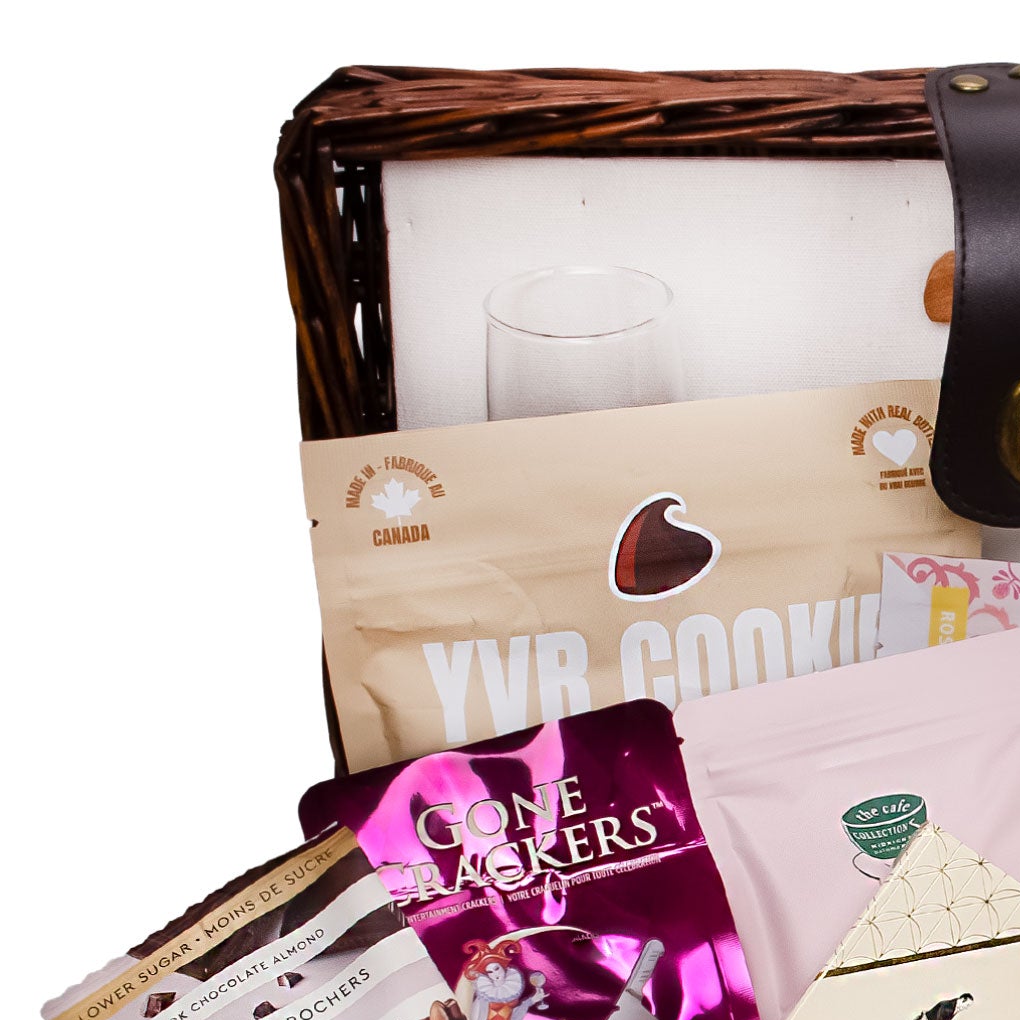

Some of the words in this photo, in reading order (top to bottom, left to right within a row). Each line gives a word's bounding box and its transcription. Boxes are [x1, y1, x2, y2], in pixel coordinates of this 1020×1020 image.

[851, 426, 867, 455] MADE
[859, 406, 886, 429] WITH
[887, 404, 912, 421] REAL
[346, 475, 366, 508] MADE
[360, 464, 376, 480] IN
[384, 456, 437, 485] FABRIQUE
[372, 523, 430, 547] CANADA
[422, 631, 591, 743] YVR
[416, 775, 587, 850] GONE
[852, 822, 909, 840] COLLECTION
[855, 807, 879, 822] the
[507, 890, 531, 903] VOTRE
[571, 871, 592, 888] POUR
[592, 868, 614, 880] TOUTE
[138, 943, 194, 983] SUGAR
[203, 900, 256, 940] MOINS
[258, 883, 283, 903] DE
[284, 848, 334, 886] SUCRE
[190, 960, 268, 1012] CHOCOLATE
[272, 928, 325, 965] ALMOND
